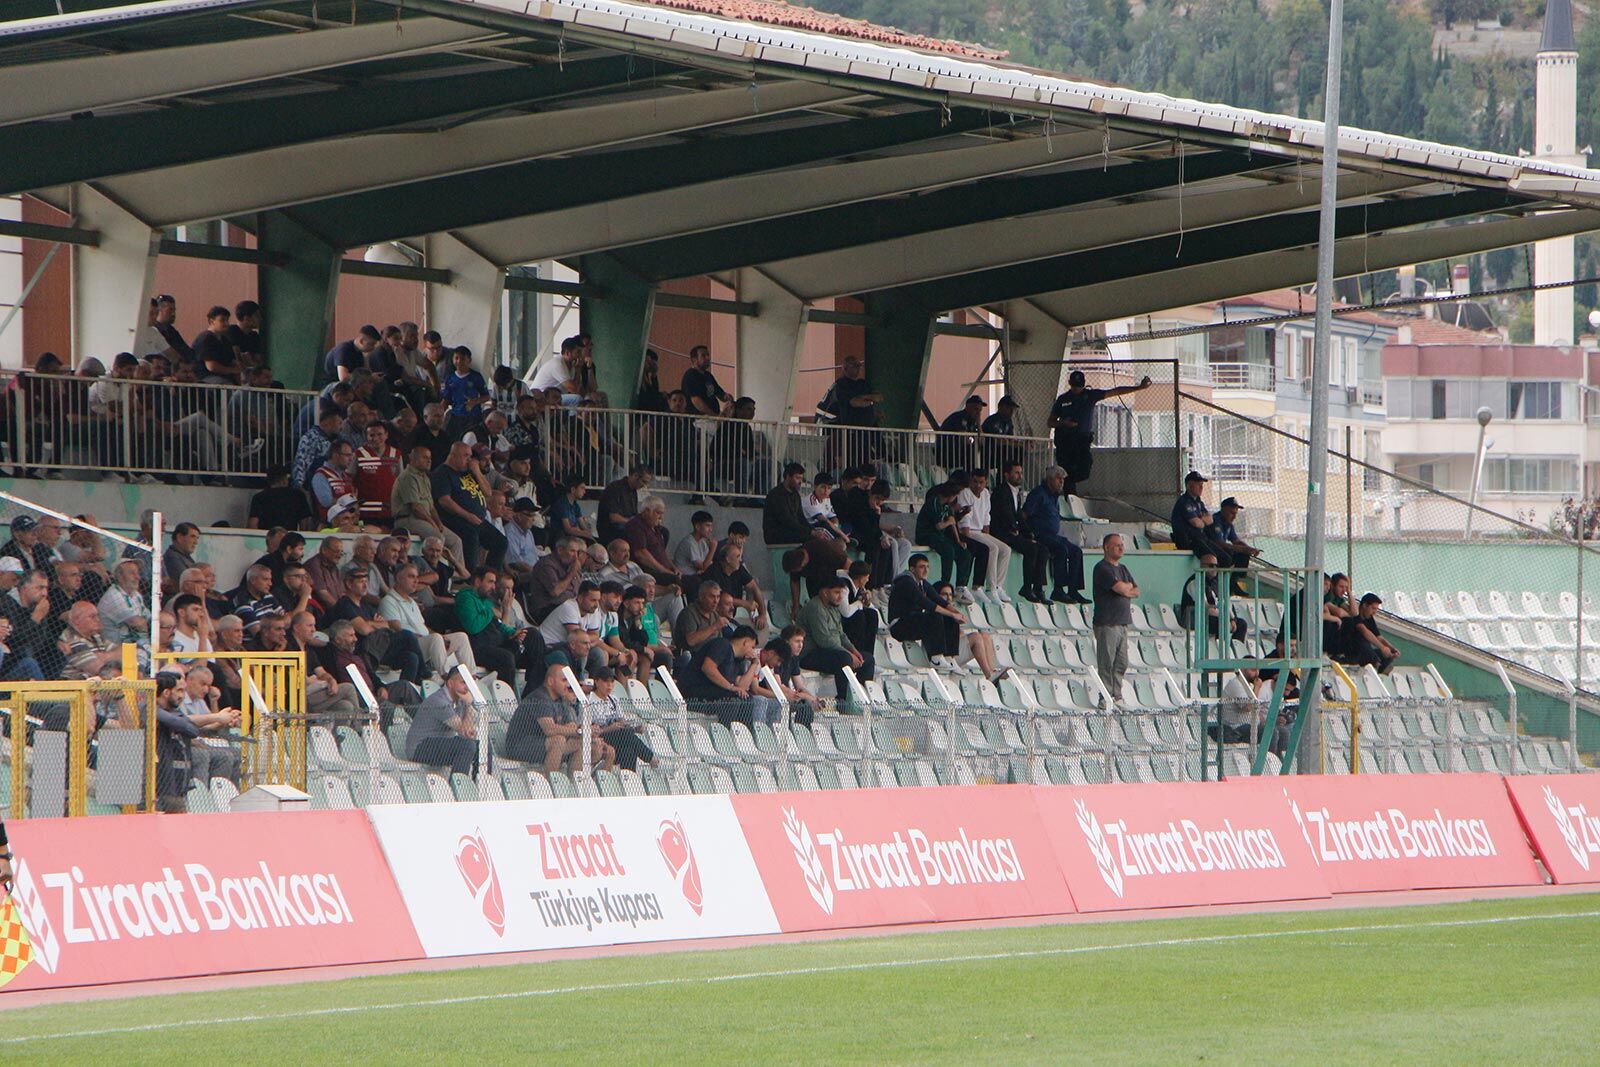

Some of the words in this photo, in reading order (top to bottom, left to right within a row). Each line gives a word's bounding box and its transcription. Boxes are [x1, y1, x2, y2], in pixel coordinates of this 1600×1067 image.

[526, 822, 625, 880] Ziraat
[816, 828, 920, 892] Ziraat
[907, 827, 1025, 886] Bankası
[1104, 816, 1197, 876] Ziraat
[1181, 818, 1286, 871] Bankası
[1306, 807, 1400, 862] Ziraat
[1387, 808, 1496, 858] Bankası
[41, 866, 200, 944] Ziraat
[184, 860, 354, 931] Bankası
[529, 888, 603, 932] Türkiye
[595, 887, 664, 928] Kupası
